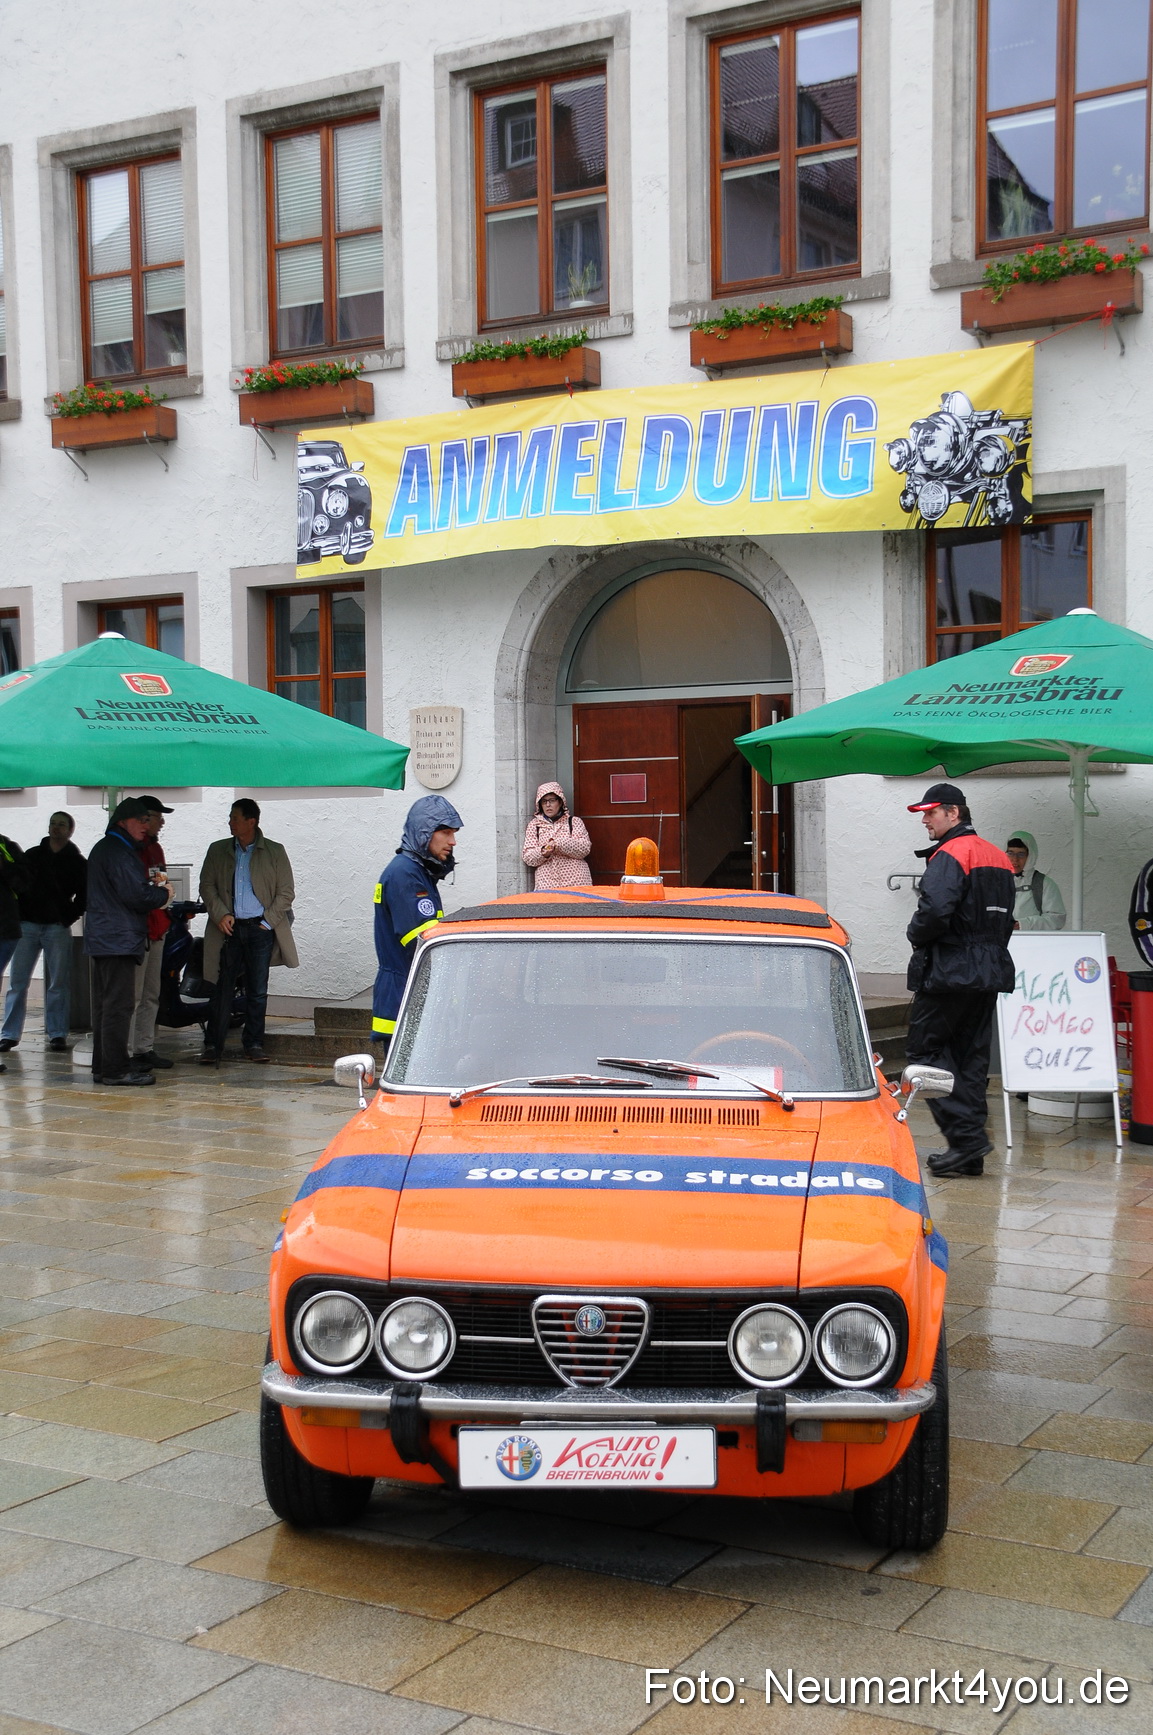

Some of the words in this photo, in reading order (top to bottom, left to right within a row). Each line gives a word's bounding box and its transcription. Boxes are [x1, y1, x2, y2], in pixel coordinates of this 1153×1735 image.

[384, 395, 878, 538] ANMELDUNG
[944, 675, 1104, 693] Neumarkter
[903, 685, 1125, 705] Lammsbräu
[96, 699, 225, 712] Neumarkter
[968, 708, 1075, 718] ÖKOLOGISCHE
[1079, 707, 1113, 715] BIER
[74, 707, 260, 725] Lammsbräu
[416, 714, 455, 724] Rathaus
[154, 725, 240, 735] ÖKOLOGISCHE
[465, 1167, 664, 1182] soccorso
[685, 1169, 886, 1190] stradale
[496, 1438, 513, 1461] ALFA
[514, 1435, 542, 1461] ROMEO
[594, 1435, 660, 1451] AUTO
[545, 1470, 651, 1480] BREITENBRUNN
